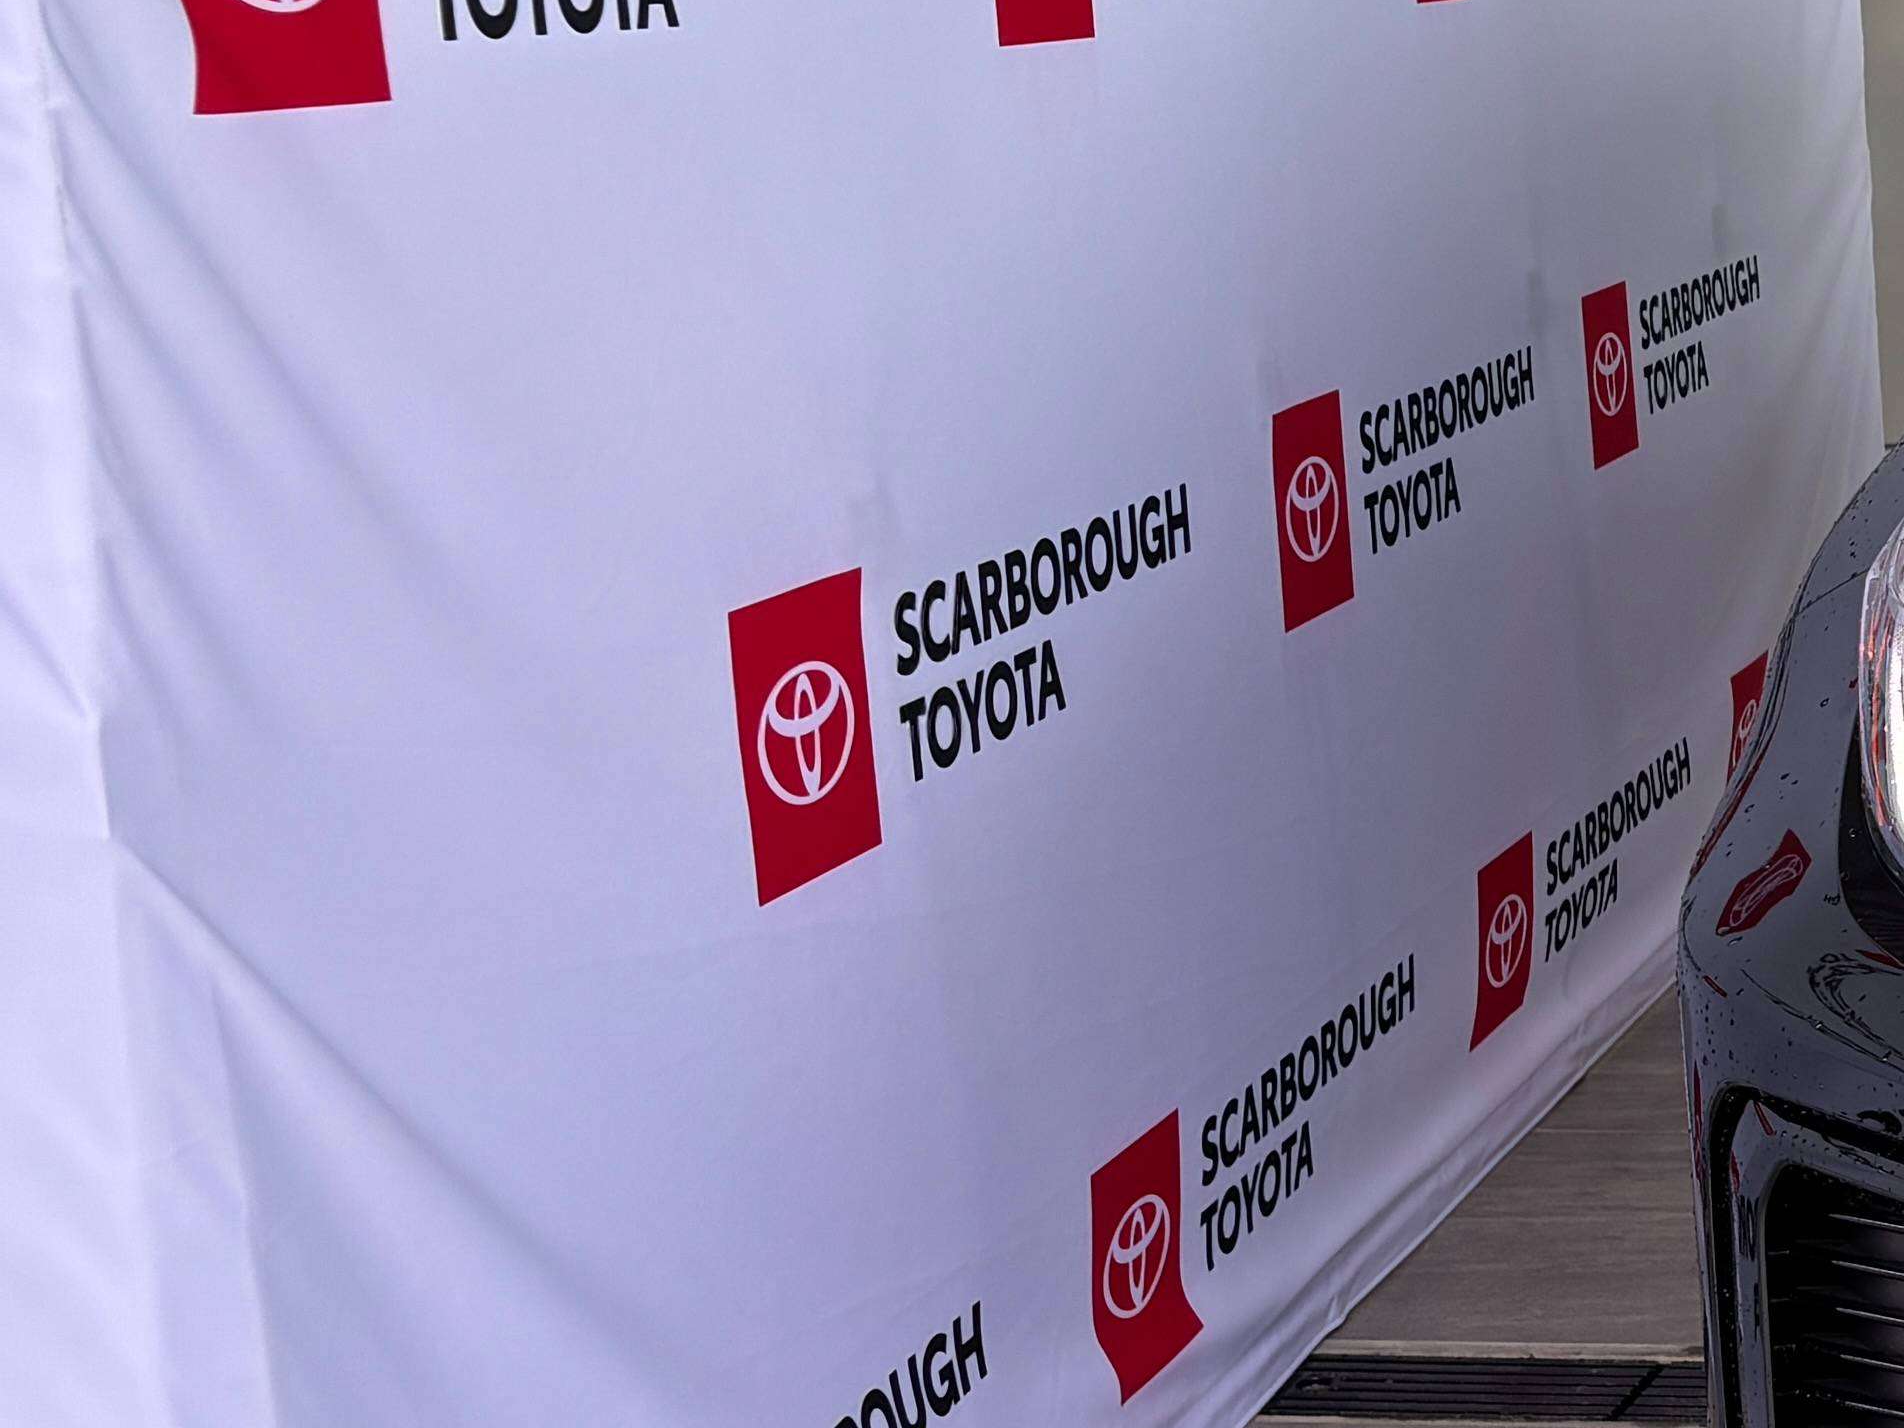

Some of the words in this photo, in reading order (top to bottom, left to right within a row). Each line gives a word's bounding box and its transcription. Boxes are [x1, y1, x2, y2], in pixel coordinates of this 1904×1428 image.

[1639, 254, 1761, 350] SCARBOROUGH
[1359, 345, 1535, 475] SCARBOROUGH
[1643, 340, 1710, 415] TOYOTA
[1363, 457, 1462, 555] TOYOTA
[894, 482, 1192, 676] SCARBOROUGH
[899, 639, 1067, 783] TOYOTA
[1546, 736, 1691, 897] SCARBOROUGH
[1544, 857, 1618, 963] TOYOTA
[1201, 952, 1415, 1187] SCARBOROUGH
[1199, 1120, 1314, 1272] TOYOTA
